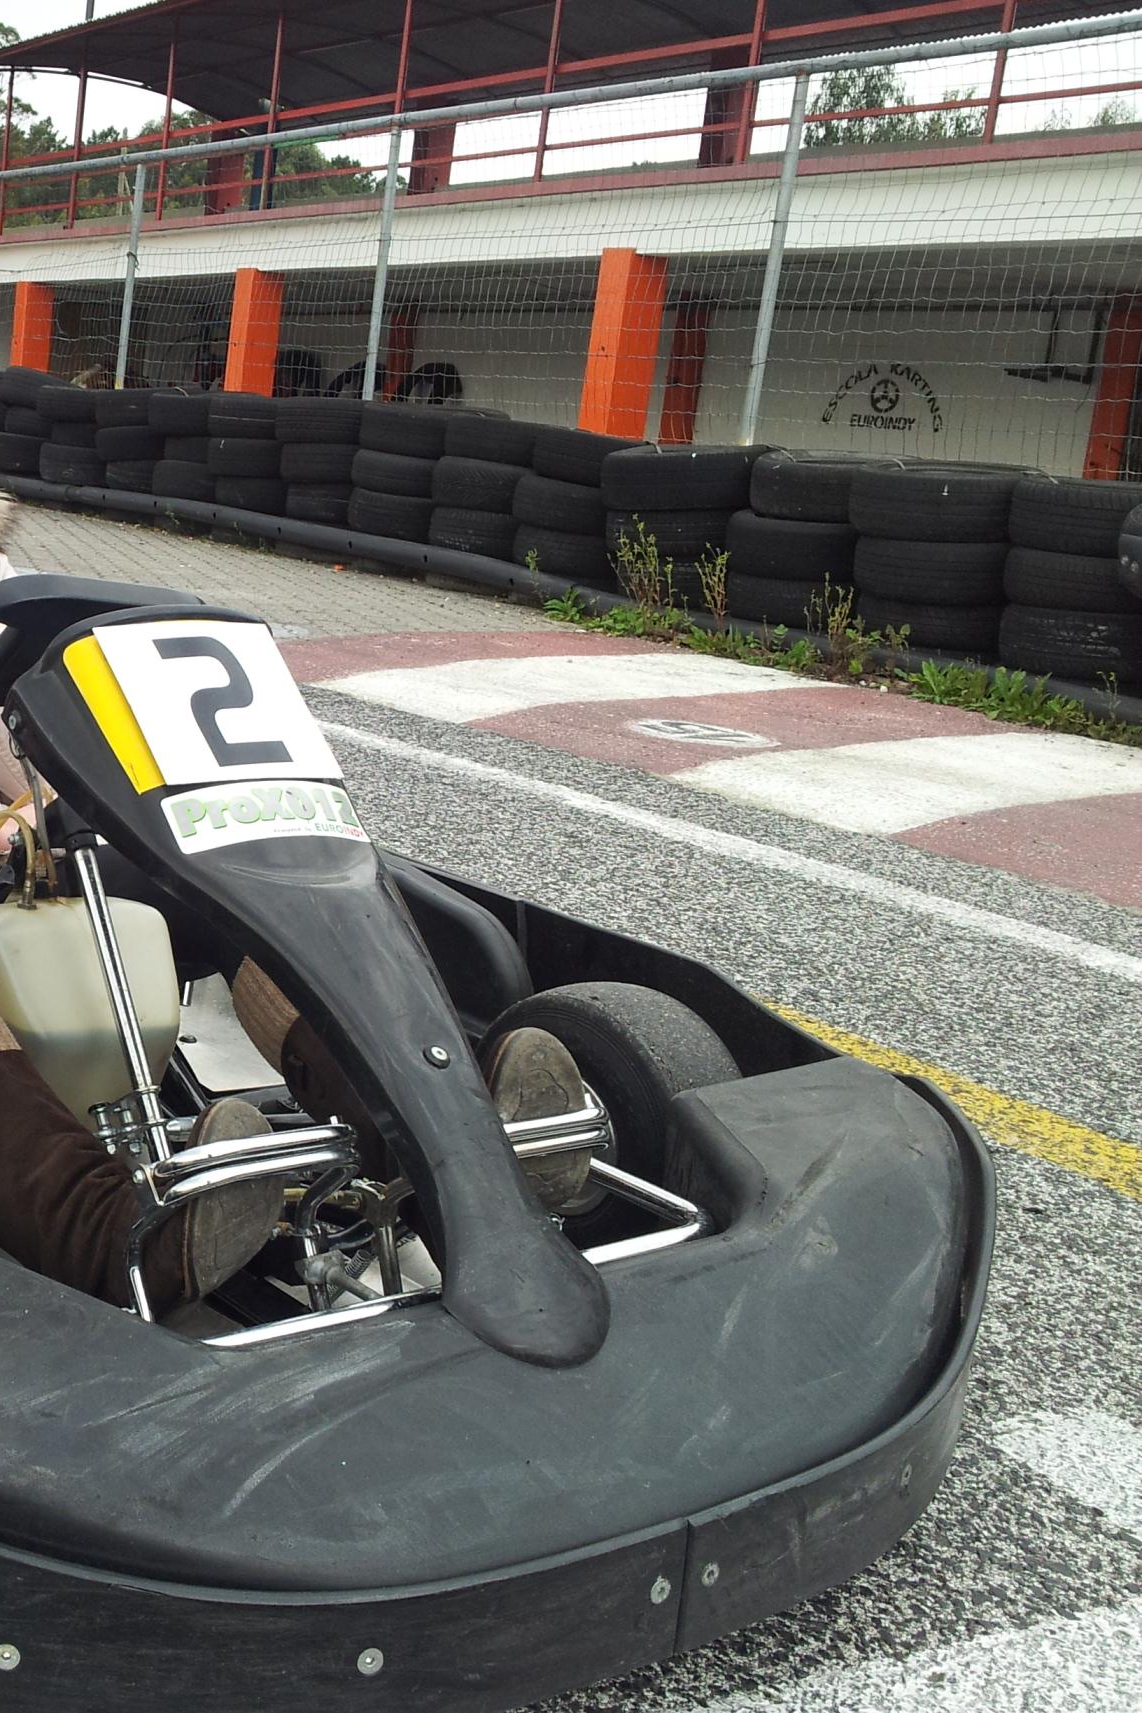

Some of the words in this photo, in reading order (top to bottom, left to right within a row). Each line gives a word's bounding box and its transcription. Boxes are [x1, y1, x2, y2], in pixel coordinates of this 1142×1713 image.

[821, 363, 879, 424] ESCOLA
[890, 363, 943, 433] KARTING
[849, 414, 916, 431] EUROINDY
[152, 636, 294, 768] 2
